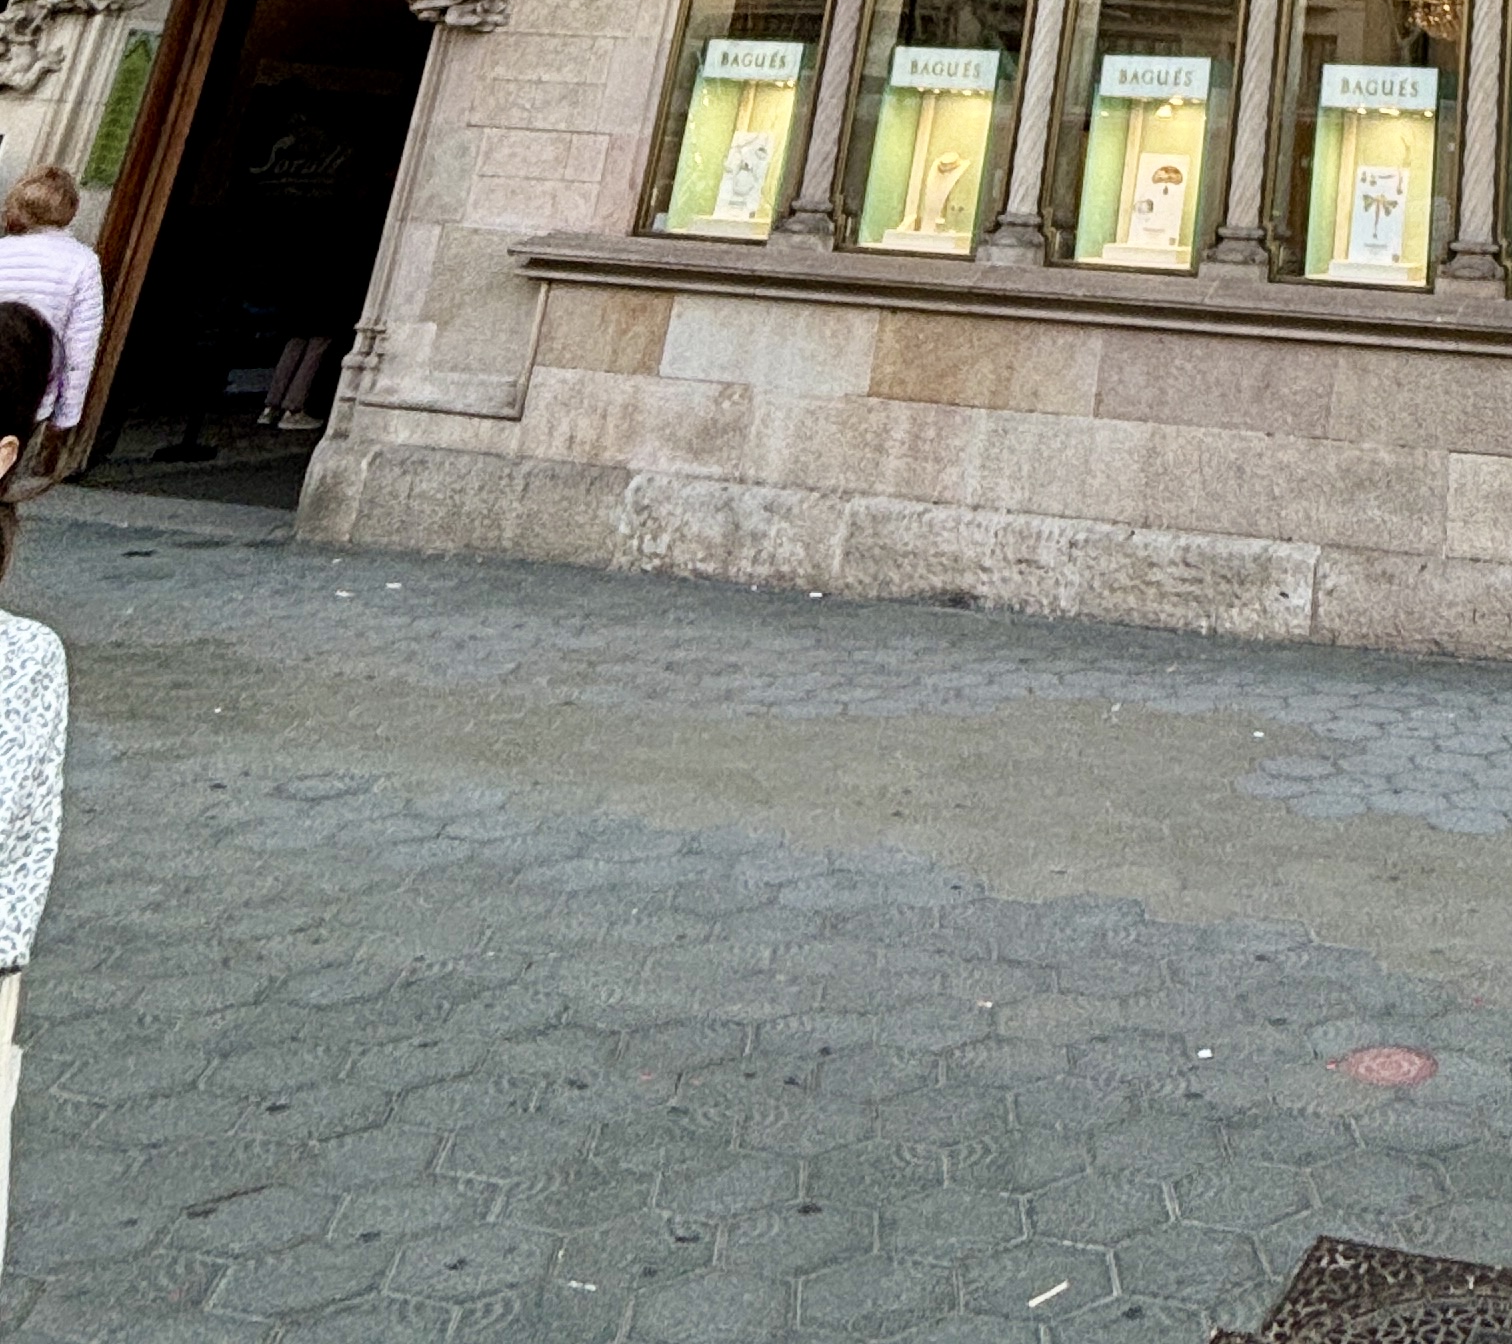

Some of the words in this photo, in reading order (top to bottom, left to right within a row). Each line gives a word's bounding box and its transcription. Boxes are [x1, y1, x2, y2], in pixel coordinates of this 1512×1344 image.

[720, 50, 787, 69] BAGUÉS
[909, 56, 981, 79] BAGUÉS
[1117, 66, 1195, 87] BAGUÉS
[1340, 76, 1420, 98] BAGUÉS
